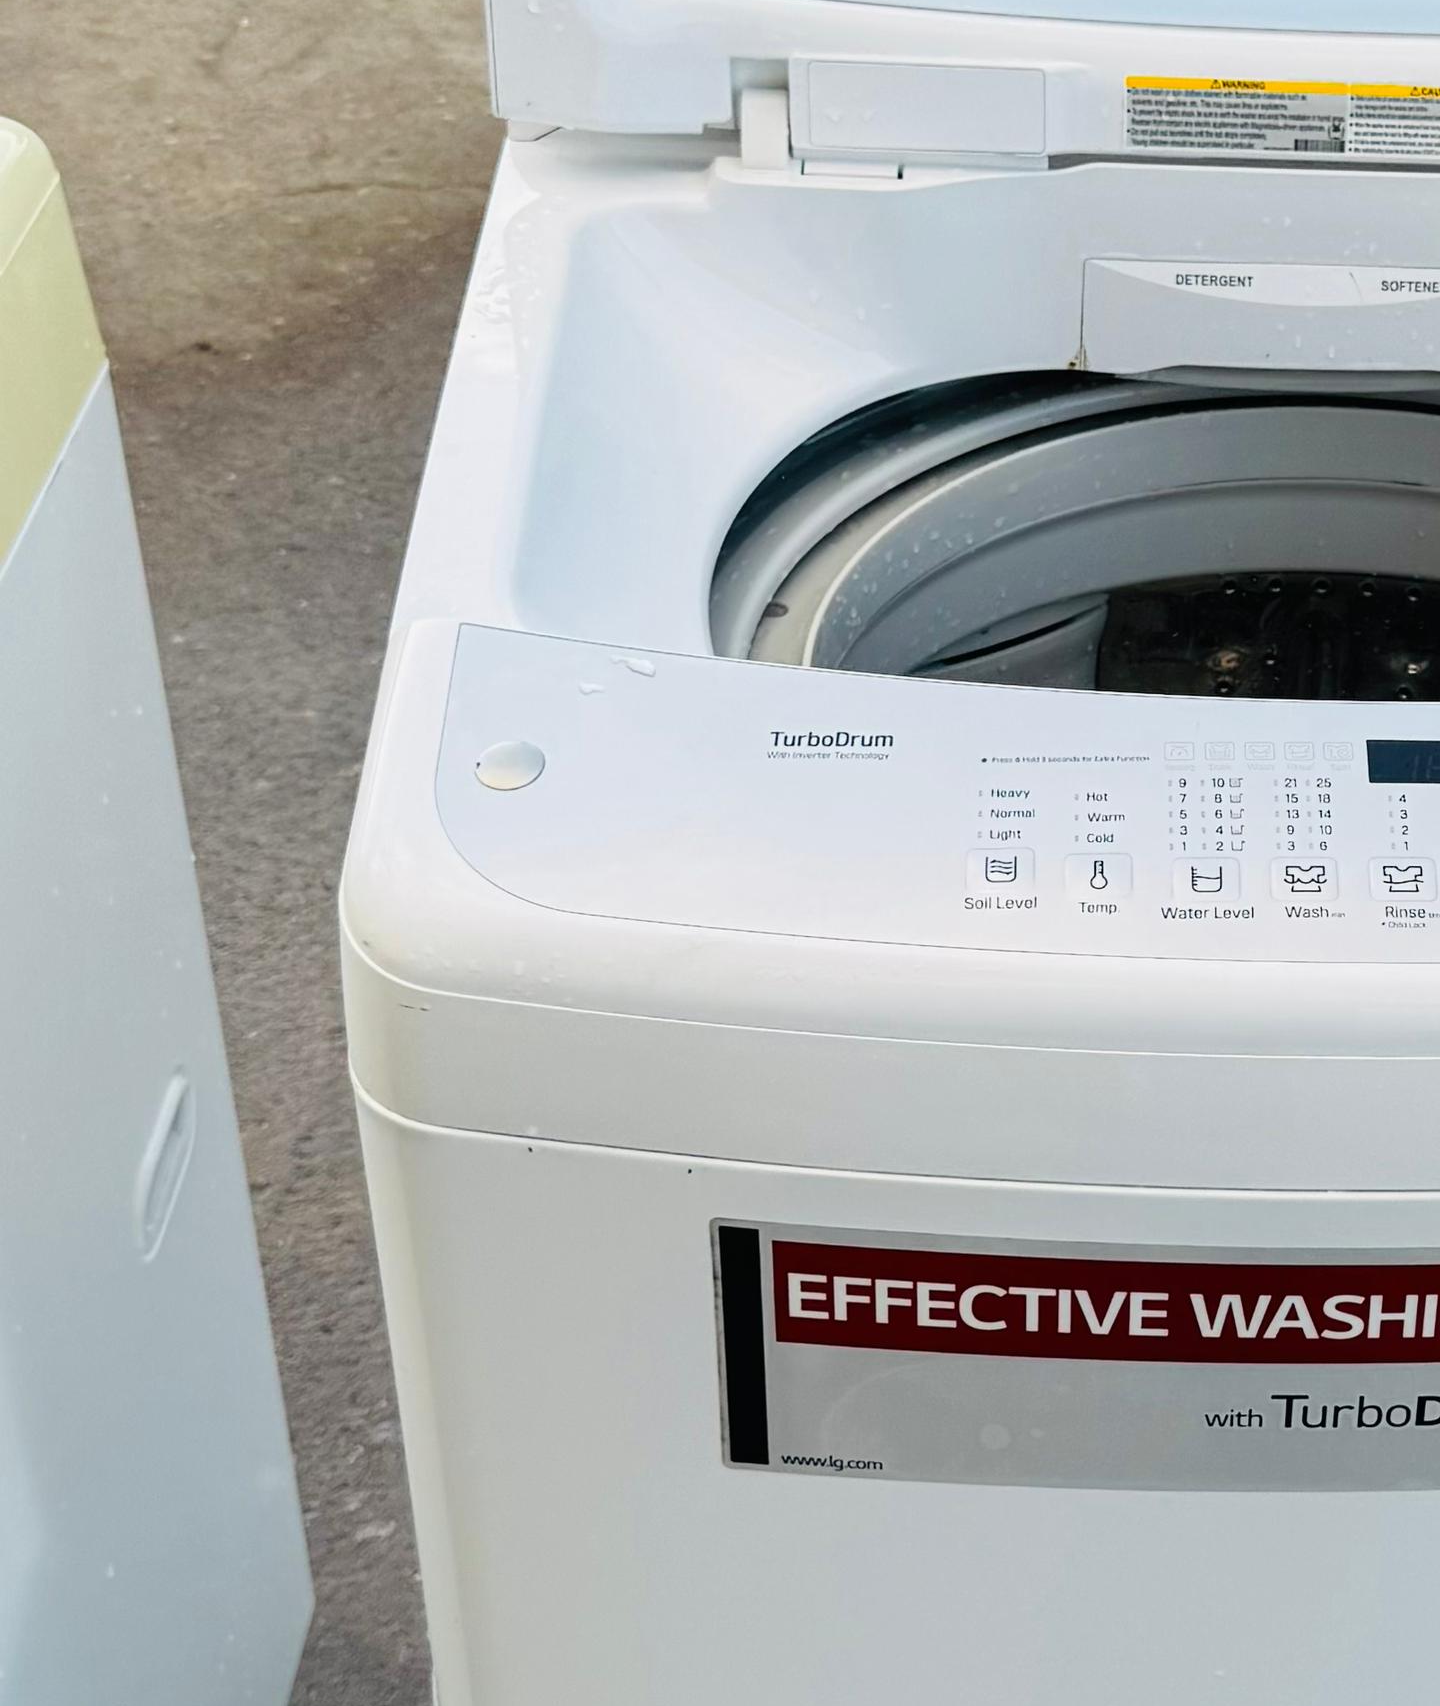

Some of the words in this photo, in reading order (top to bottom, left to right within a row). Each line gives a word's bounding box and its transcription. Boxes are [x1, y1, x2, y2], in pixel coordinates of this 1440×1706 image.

[1222, 80, 1266, 90] WARNING
[1175, 273, 1253, 289] DETERGENT
[770, 731, 894, 747] TurboDrum
[835, 752, 889, 760] Technology
[1179, 778, 1186, 788] 9
[1212, 778, 1224, 788] 10
[1285, 778, 1297, 788] 21
[1317, 778, 1331, 788] 25
[991, 789, 1030, 800] Heavy
[1086, 792, 1108, 802] Hot
[1179, 794, 1186, 803] 7
[1215, 794, 1222, 803] 8
[1286, 794, 1298, 803] 15
[1318, 794, 1331, 803] 18
[1399, 794, 1406, 803] 4
[990, 808, 1035, 819] Normal
[1087, 812, 1125, 822] Warm
[1179, 810, 1187, 819] 5
[1215, 810, 1223, 819] 6
[1287, 810, 1299, 819] 13
[1319, 810, 1331, 819] 14
[1400, 810, 1407, 819] 3
[989, 828, 1021, 841] Light
[1180, 826, 1187, 835] 3
[1216, 826, 1223, 835] 4
[1287, 825, 1294, 835] 9
[1320, 826, 1332, 835] 10
[1402, 826, 1409, 835] 2
[1086, 833, 1114, 843] Cold
[1182, 842, 1186, 851] 1
[1216, 842, 1223, 851] 2
[1288, 842, 1295, 851] 3
[1320, 842, 1327, 851] 6
[1404, 842, 1409, 851] 1
[964, 897, 992, 911] Soil
[997, 896, 1038, 910] Level
[1079, 901, 1120, 915] Temp.
[1161, 907, 1209, 919] Water
[1214, 907, 1255, 919] Level
[1285, 906, 1329, 918] Wash
[1385, 906, 1426, 918] Rinse
[786, 1271, 1170, 1337] EFFECTIVE
[1204, 1408, 1264, 1429] with
[781, 1453, 884, 1473] www.lg.com
